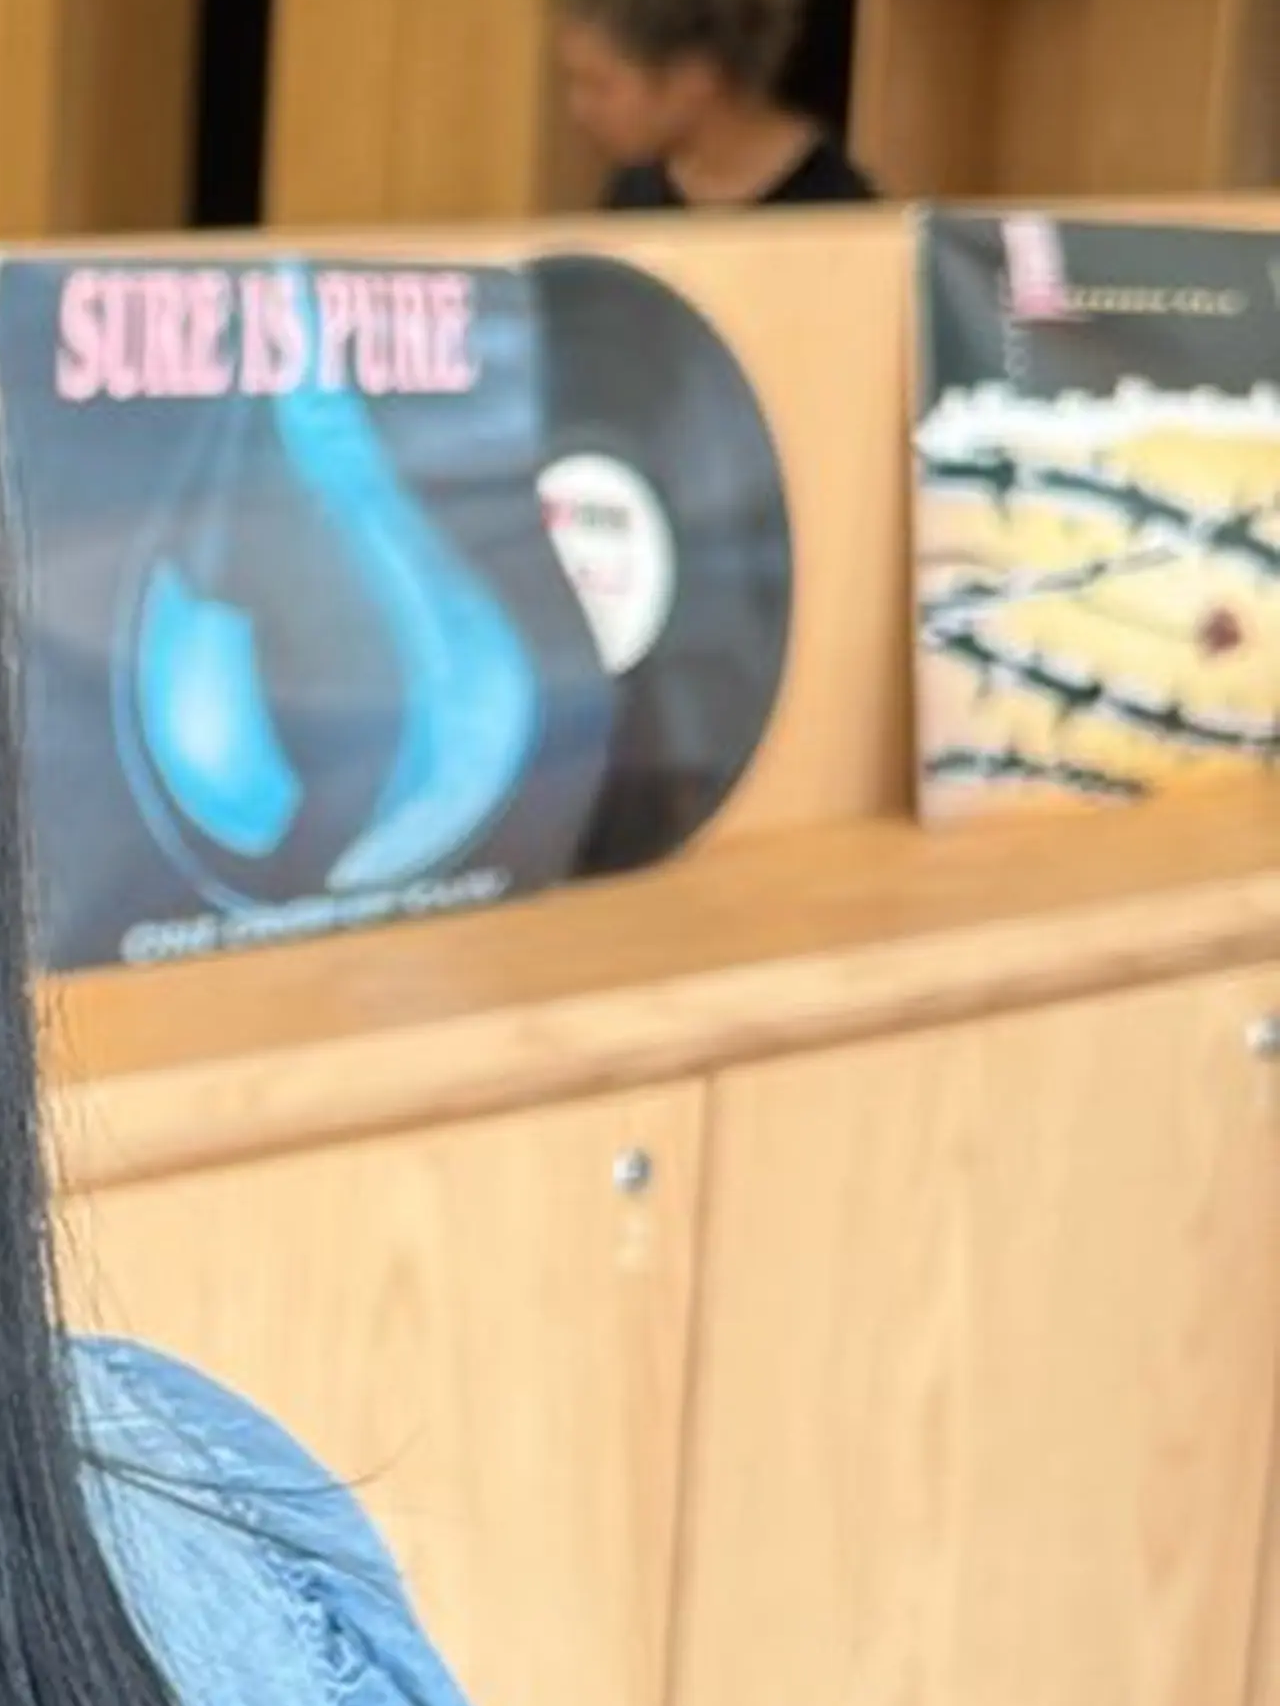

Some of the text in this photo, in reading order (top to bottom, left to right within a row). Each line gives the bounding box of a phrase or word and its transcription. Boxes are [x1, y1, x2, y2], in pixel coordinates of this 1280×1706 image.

[57, 270, 477, 397] SURE IS PURE
